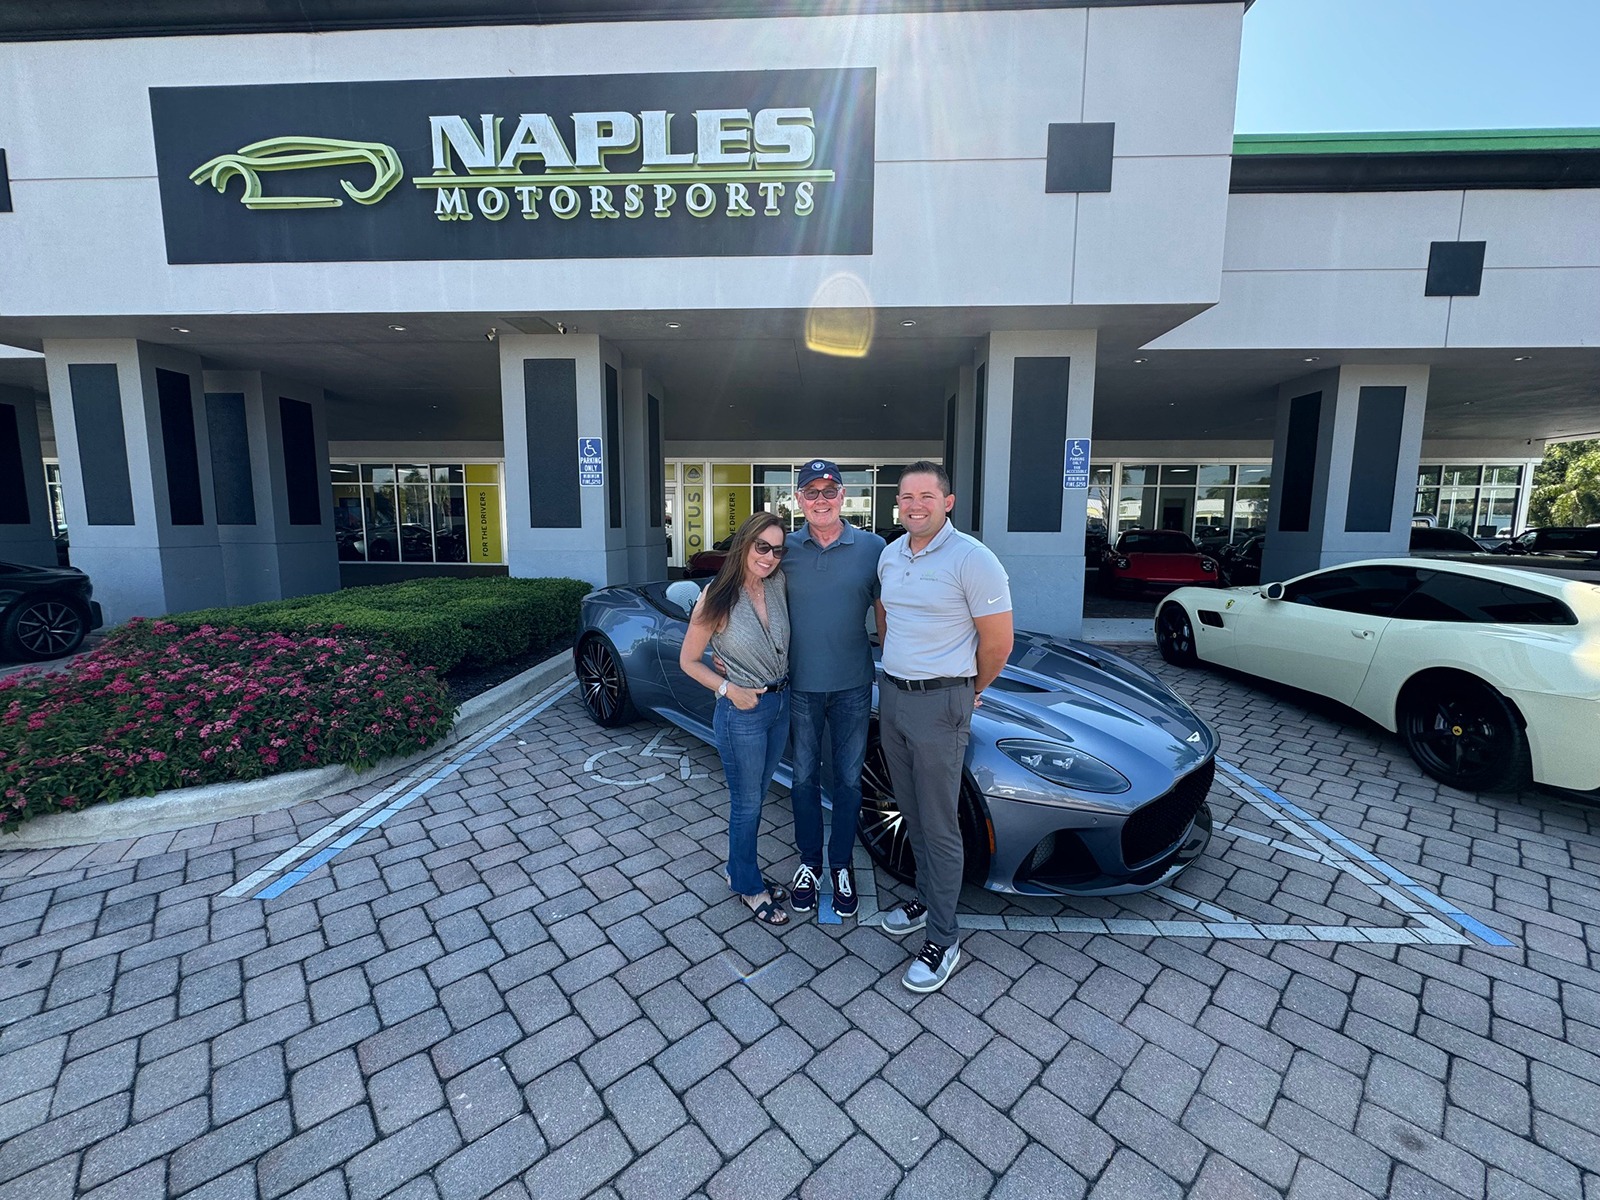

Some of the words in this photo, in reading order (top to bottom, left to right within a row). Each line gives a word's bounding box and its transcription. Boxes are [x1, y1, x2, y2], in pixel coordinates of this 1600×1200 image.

[429, 107, 815, 175] NAPLES
[434, 182, 815, 221] MOTORSPORTS
[688, 492, 701, 559] OTUS
